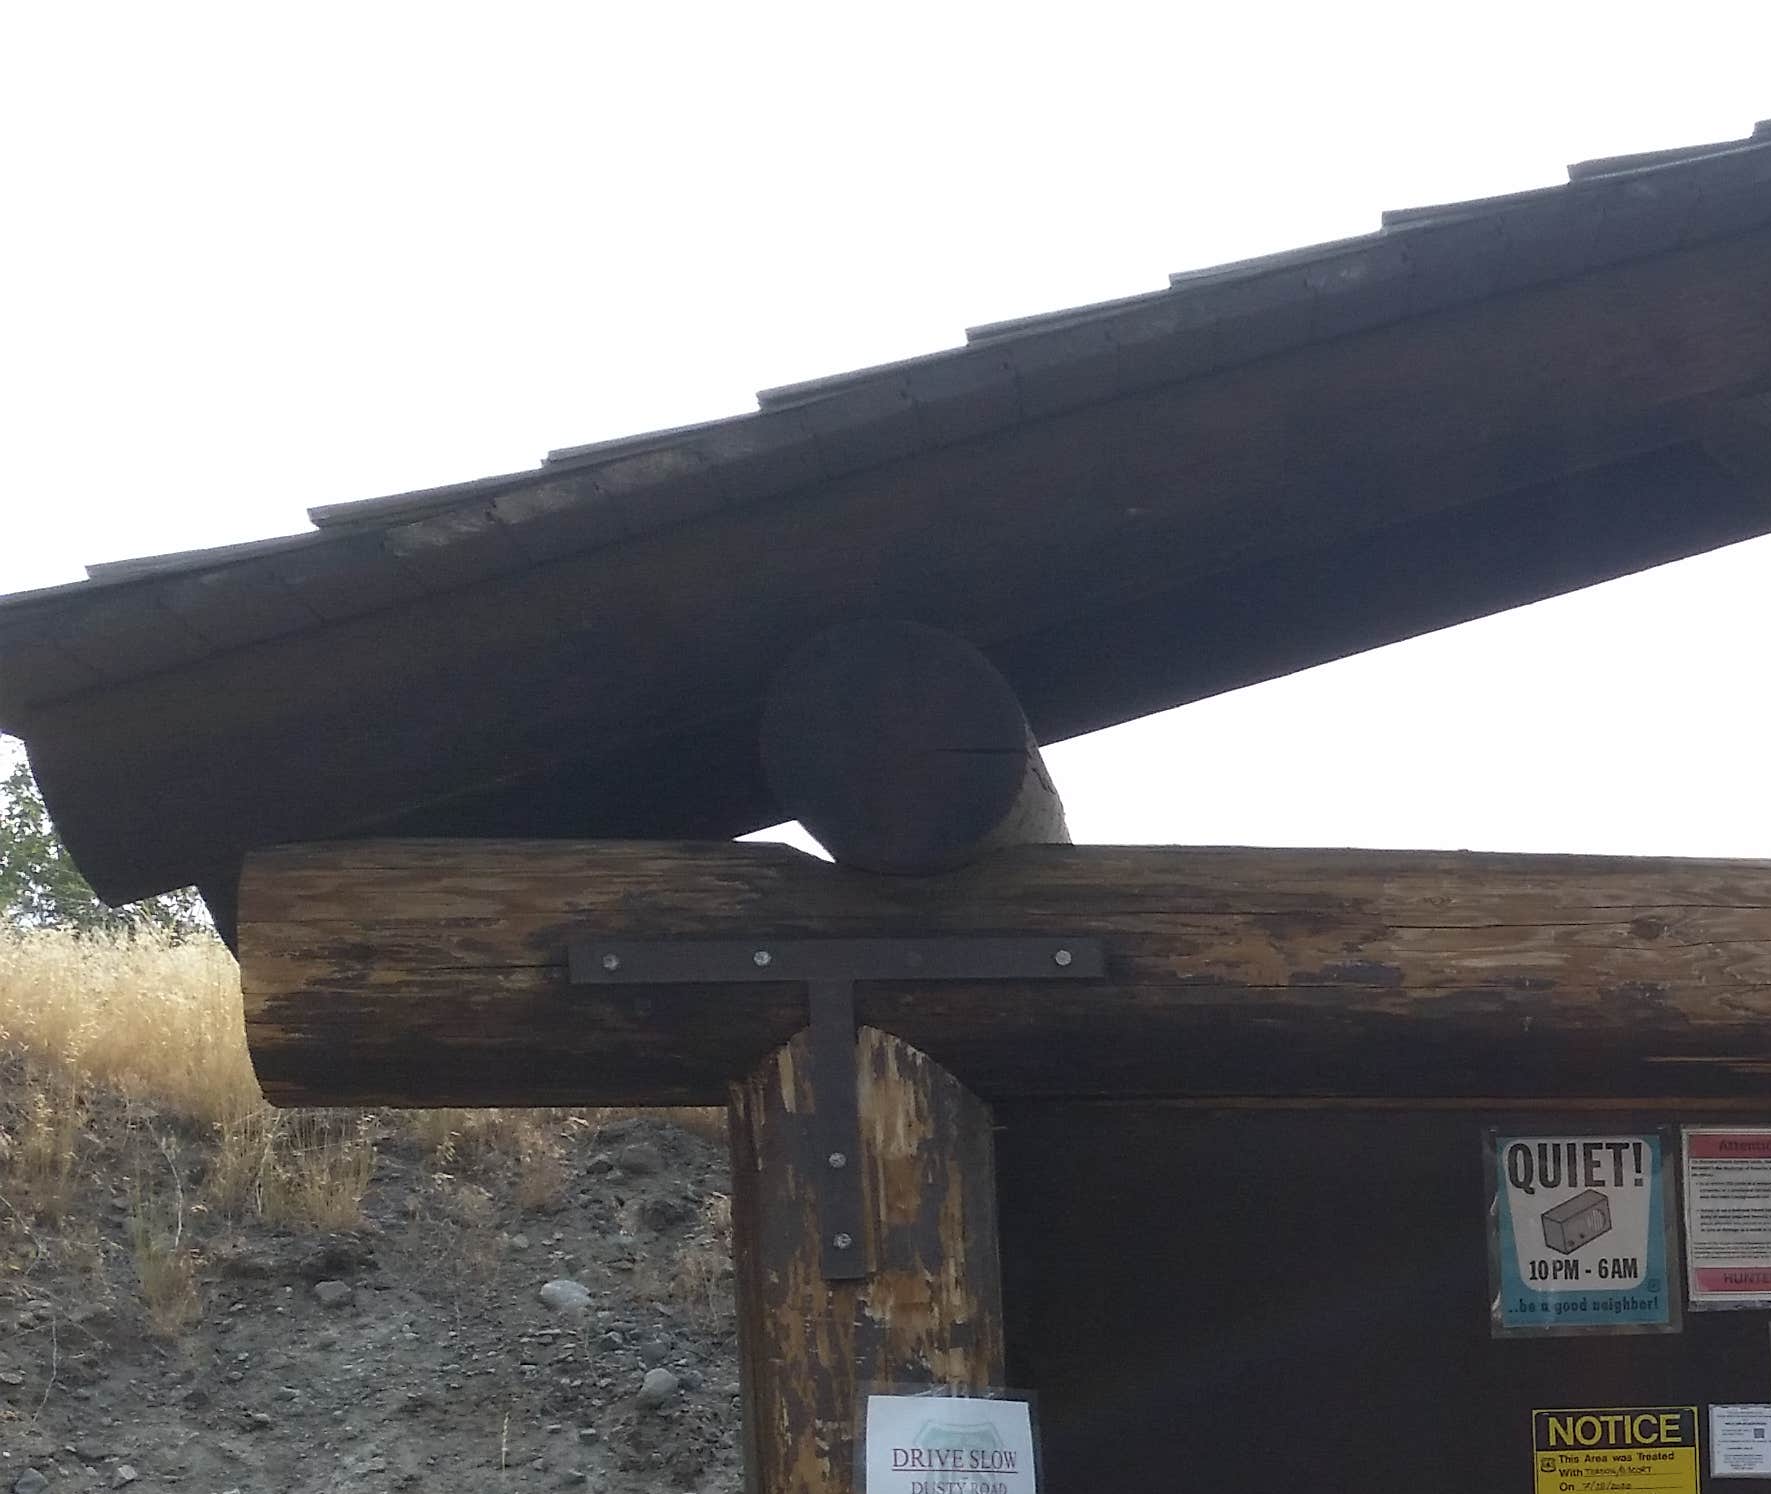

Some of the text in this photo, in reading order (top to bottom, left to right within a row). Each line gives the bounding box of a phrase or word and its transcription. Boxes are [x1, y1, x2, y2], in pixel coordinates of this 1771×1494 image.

[1507, 1142, 1645, 1194] QUIET!
[1541, 1295, 1659, 1315] a good neighbor!
[1548, 1413, 1683, 1447] NOTICE
[892, 1448, 1017, 1470] DRIVE SLOW
[1559, 1455, 1580, 1463] This
[1584, 1454, 1608, 1463] Area
[1637, 1452, 1675, 1461] Treated
[1559, 1468, 1584, 1477] With
[1559, 1482, 1575, 1491] On
